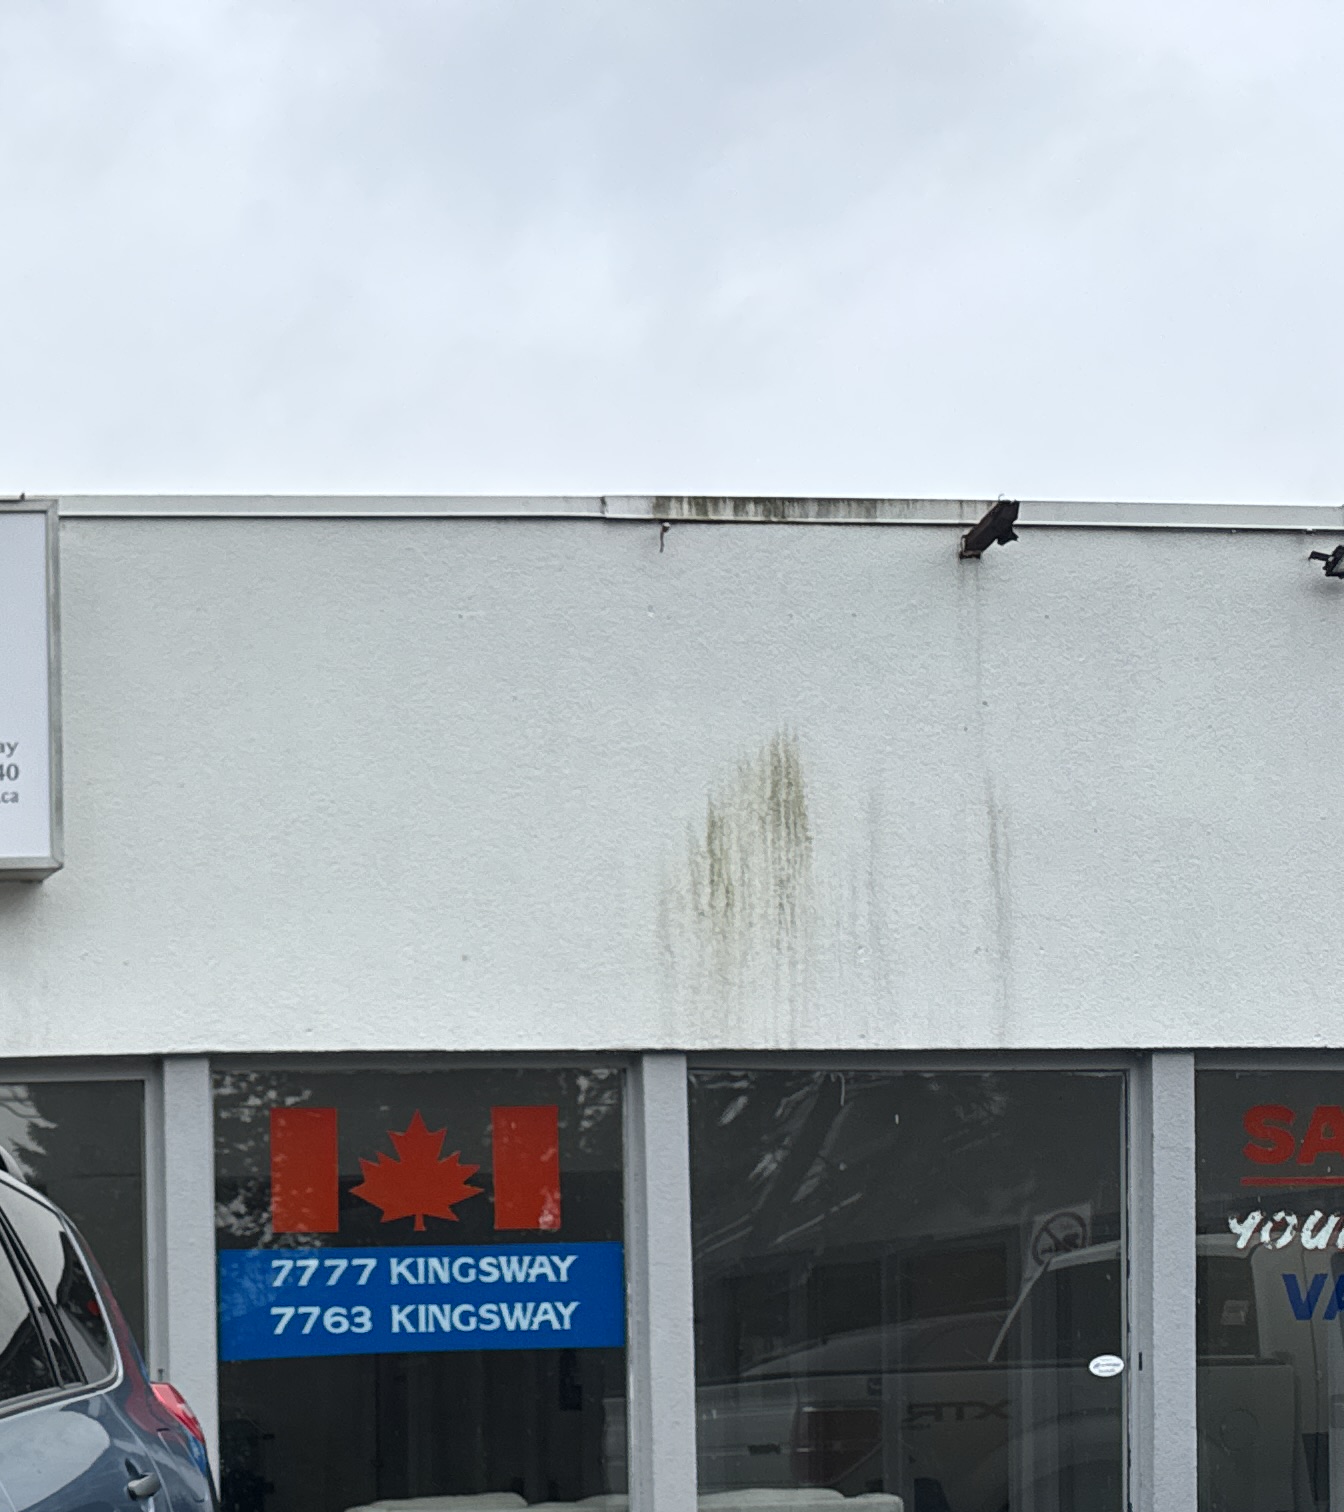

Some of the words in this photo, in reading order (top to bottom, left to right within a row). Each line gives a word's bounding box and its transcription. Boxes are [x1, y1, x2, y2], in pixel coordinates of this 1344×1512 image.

[1228, 1210, 1344, 1250] YOU
[271, 1257, 377, 1287] 7777
[390, 1254, 578, 1285] KINGSWAY
[270, 1305, 373, 1334] 7763
[391, 1301, 580, 1333] KINGSWAY
